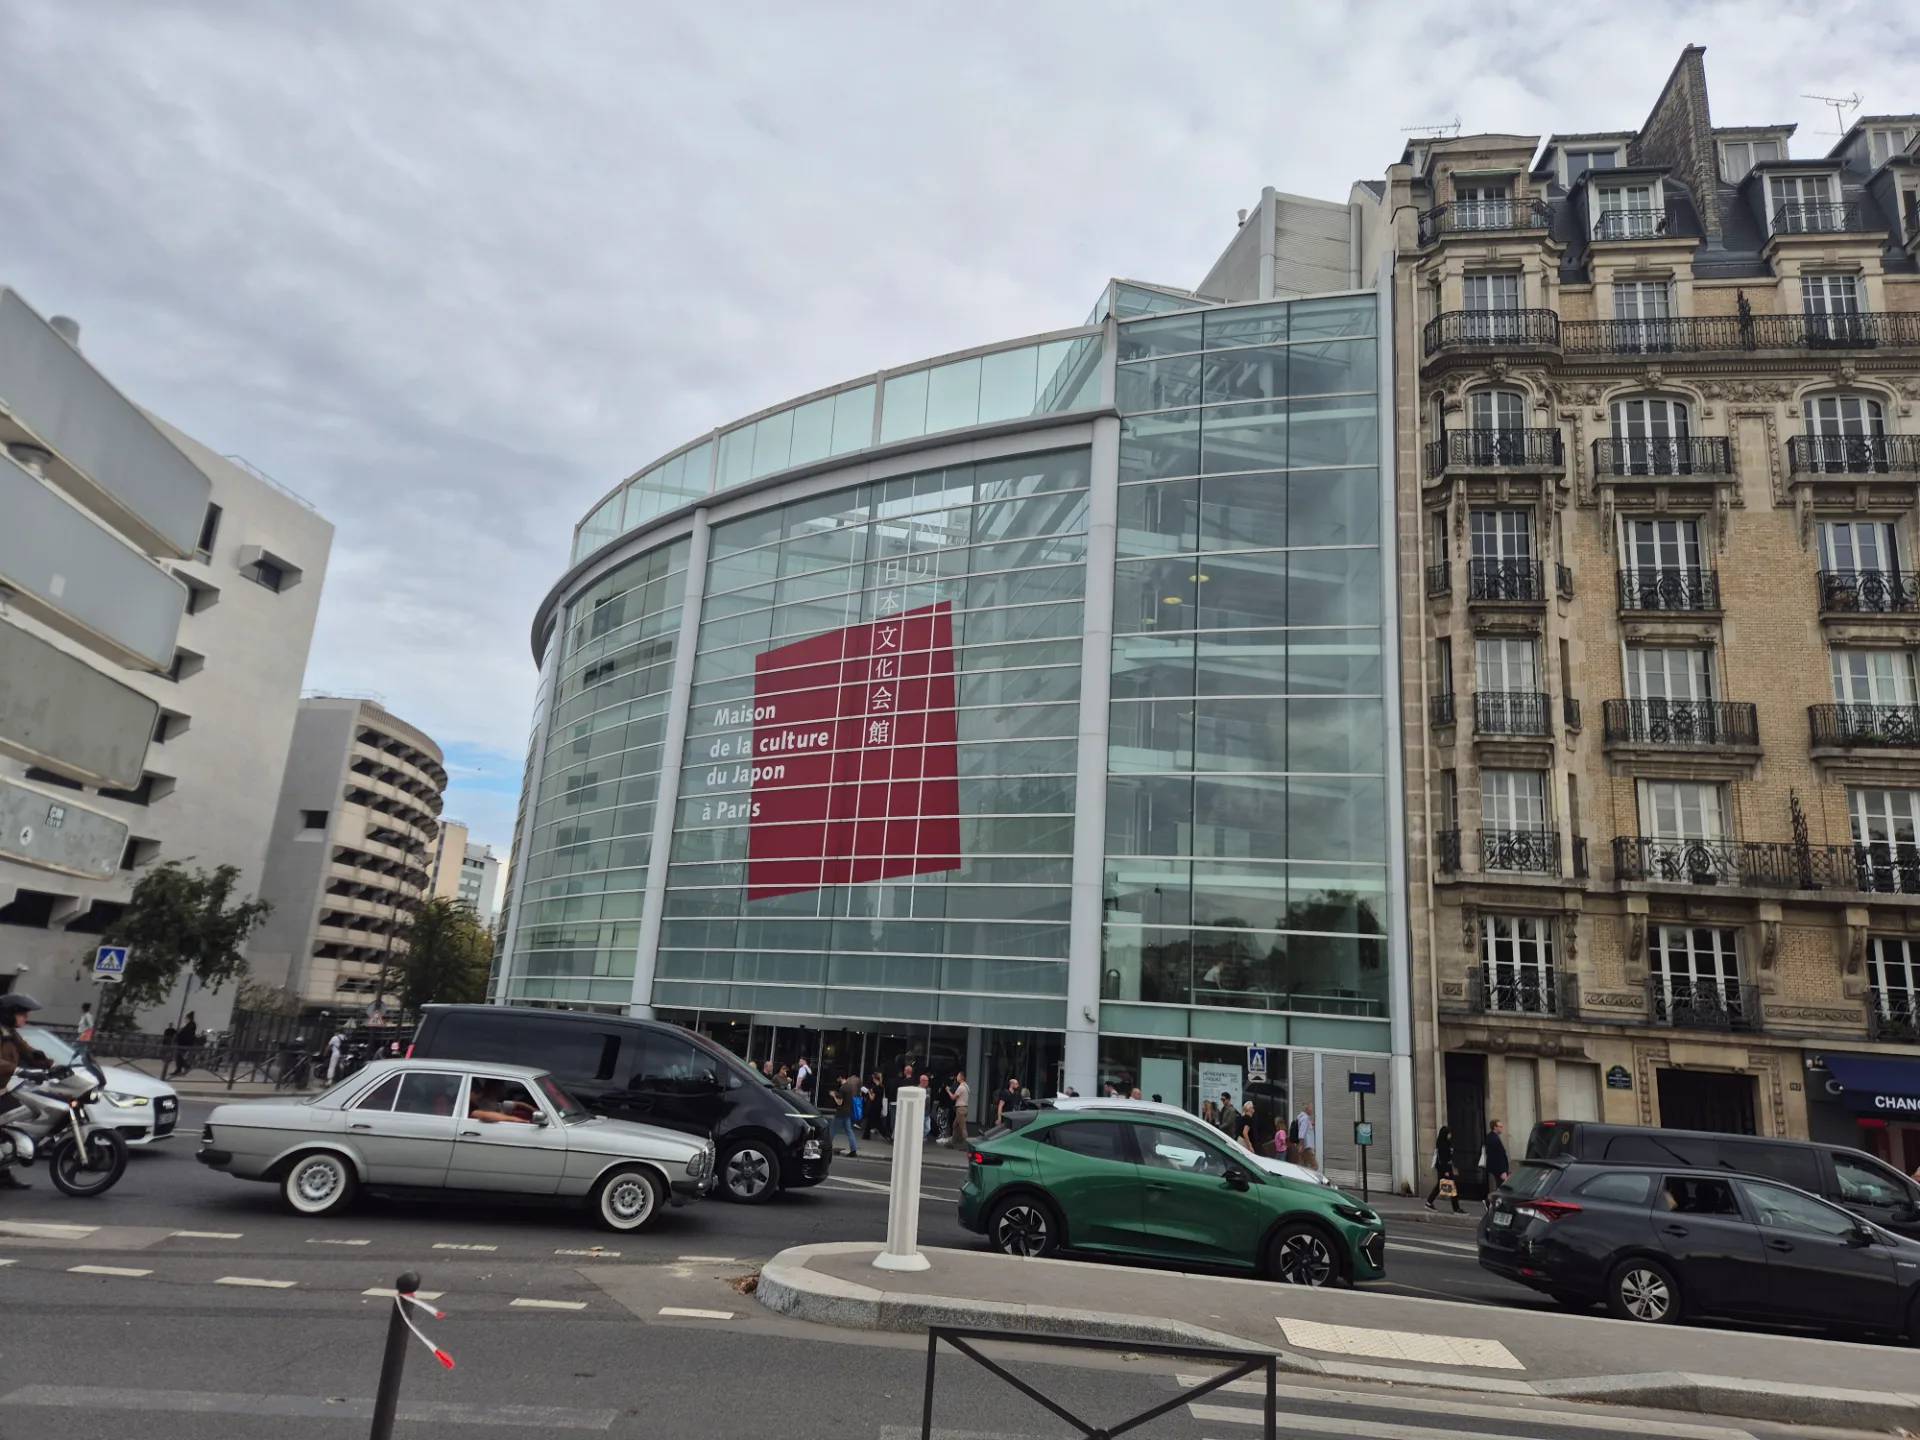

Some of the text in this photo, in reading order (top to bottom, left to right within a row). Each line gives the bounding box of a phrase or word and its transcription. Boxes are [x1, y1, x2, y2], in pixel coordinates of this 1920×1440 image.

[867, 560, 900, 745] 日本文化会館
[713, 704, 776, 726] Maison
[709, 730, 829, 758] de la culture
[706, 764, 785, 787] du Japon
[702, 798, 760, 820] à Paris
